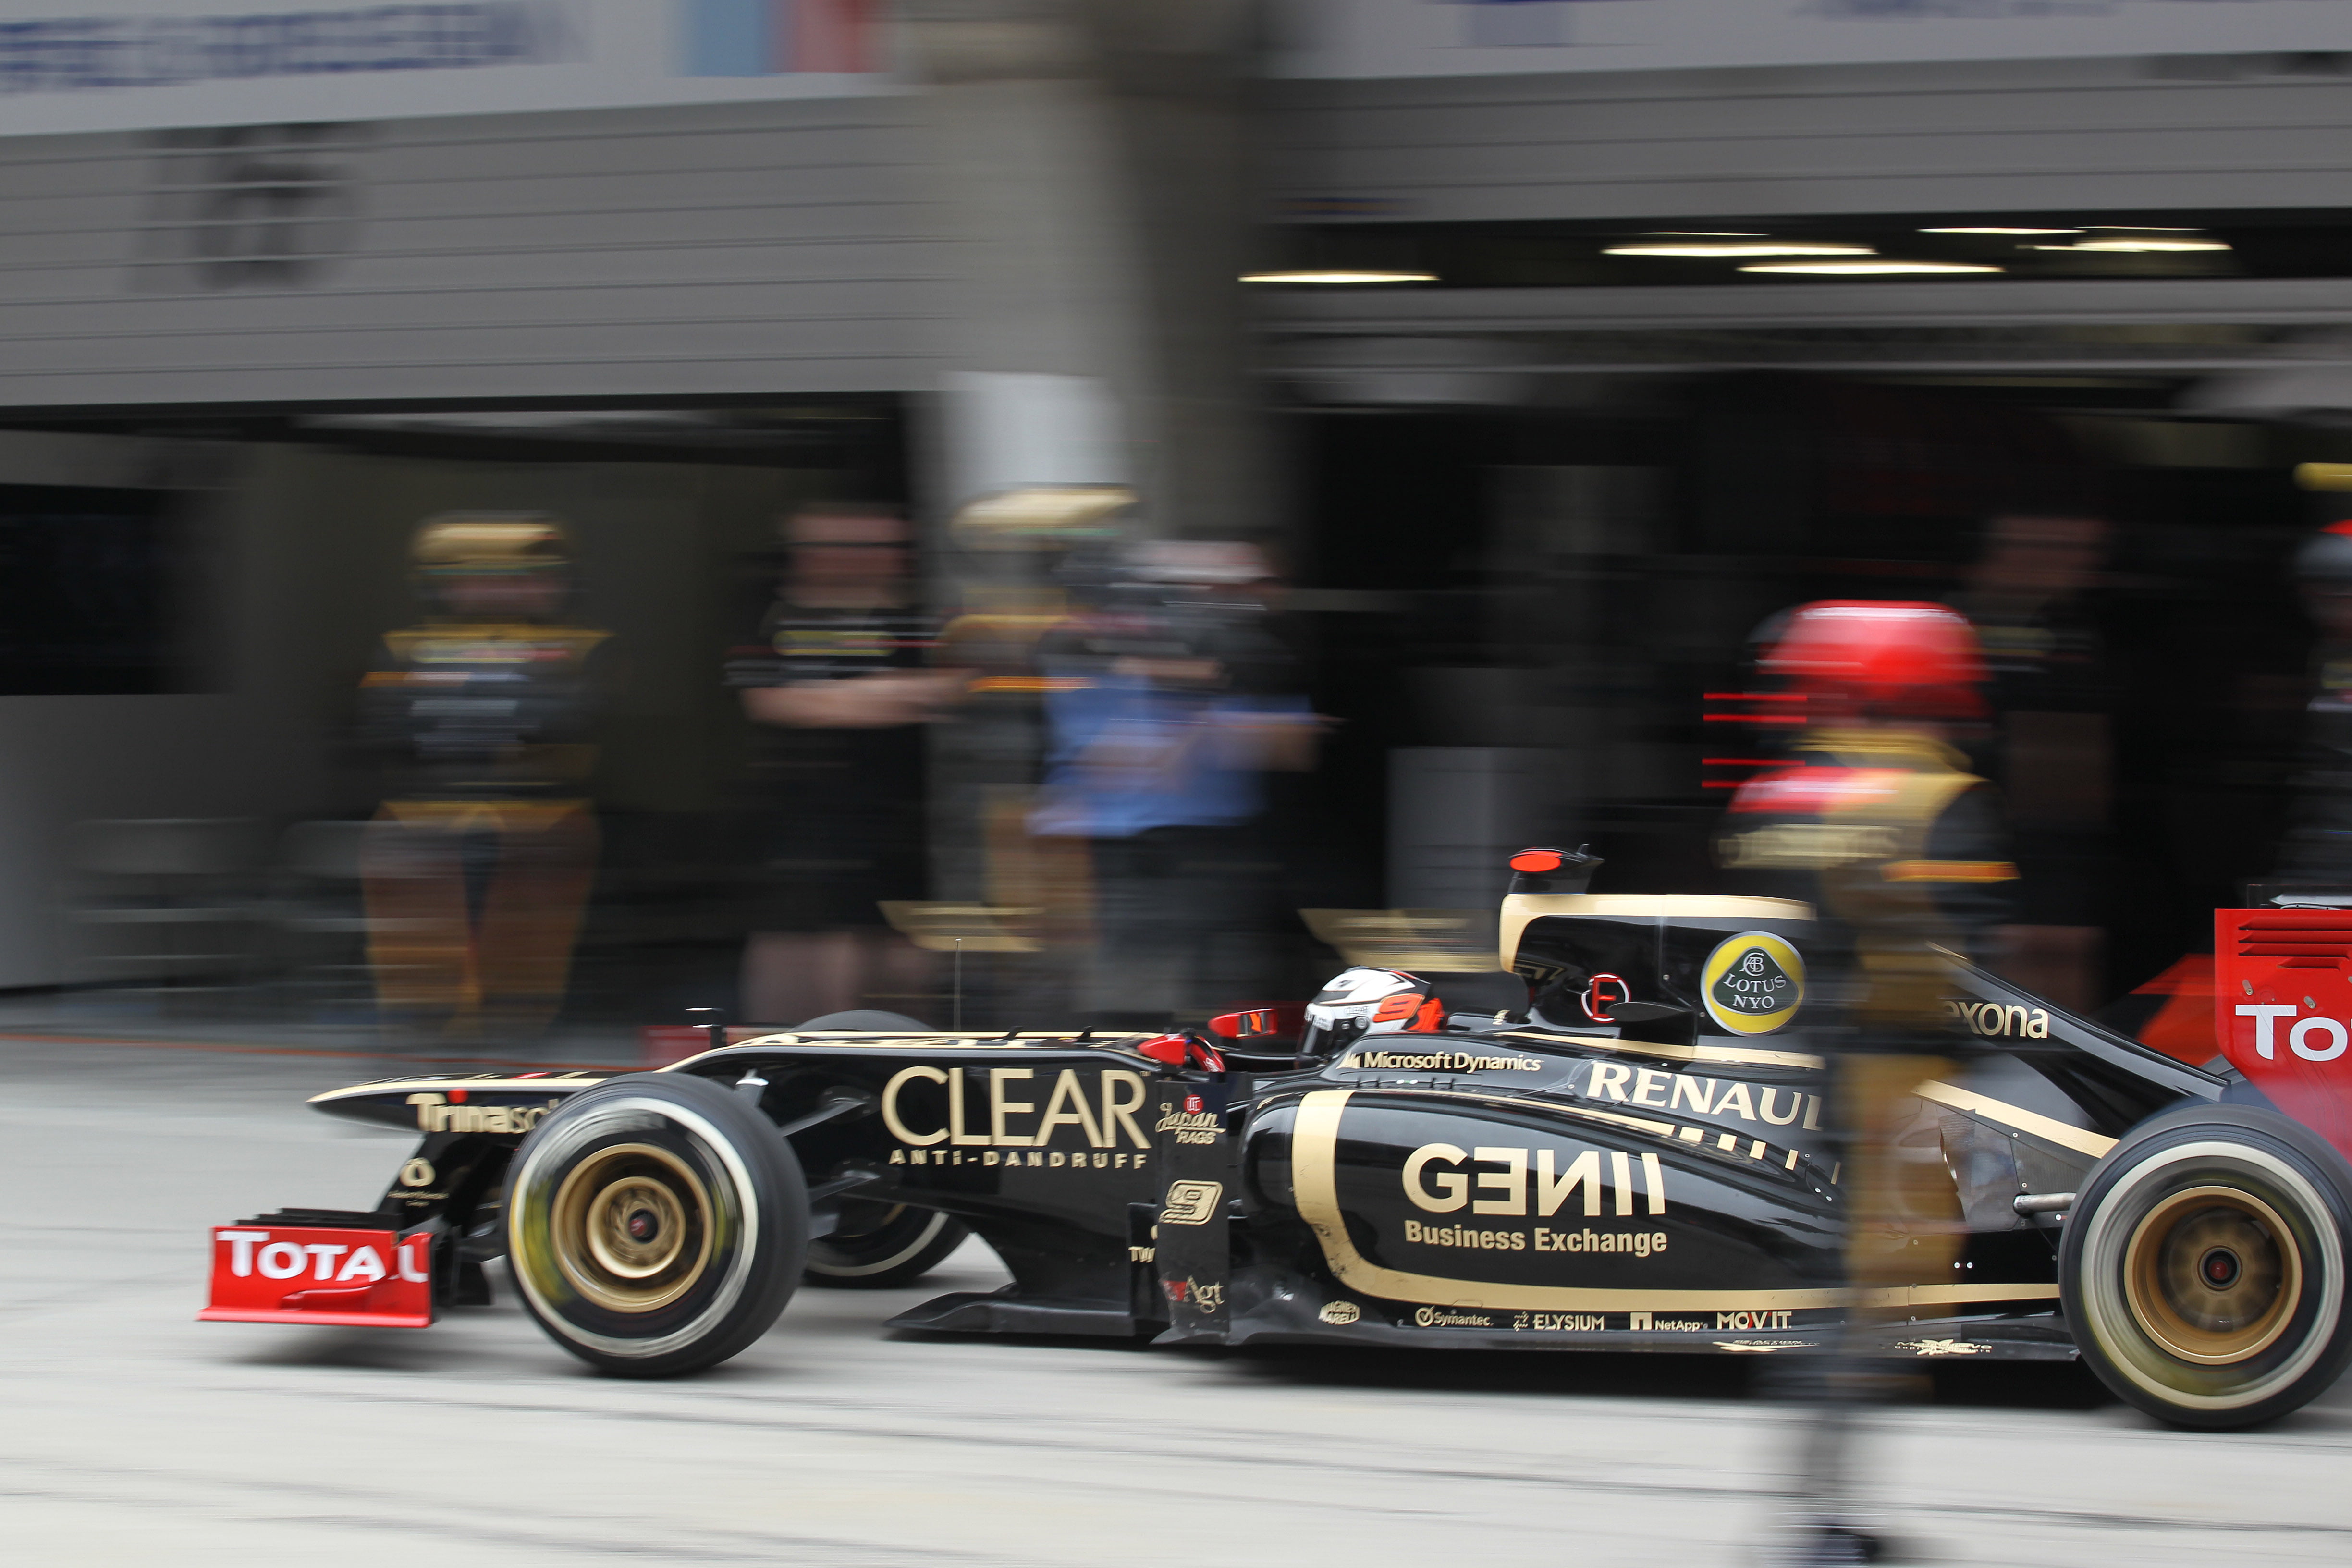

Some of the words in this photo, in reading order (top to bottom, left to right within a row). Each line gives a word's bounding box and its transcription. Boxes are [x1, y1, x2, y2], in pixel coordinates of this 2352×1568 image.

[1723, 973, 1786, 992] LOTUS
[1732, 995, 1775, 1009] NYO
[2235, 1004, 2352, 1062] TO
[1364, 1051, 1453, 1069] Microsoft
[1454, 1052, 1542, 1074] Dynamics
[882, 1066, 1152, 1149] CLEAR
[1586, 1060, 1824, 1132] RENAUL
[1155, 1102, 1226, 1135] Japan
[1176, 1130, 1217, 1145] RAGS
[888, 1149, 1148, 1169] ANTI-DANDRUFF
[1158, 1179, 1223, 1225] 9
[1404, 1220, 1526, 1250] Business
[1534, 1228, 1667, 1258] Exchange
[216, 1230, 429, 1283] TOTAL
[1433, 1312, 1491, 1327] Symantec
[1533, 1314, 1605, 1332] ELYSIUM
[1655, 1320, 1701, 1332] NetApp
